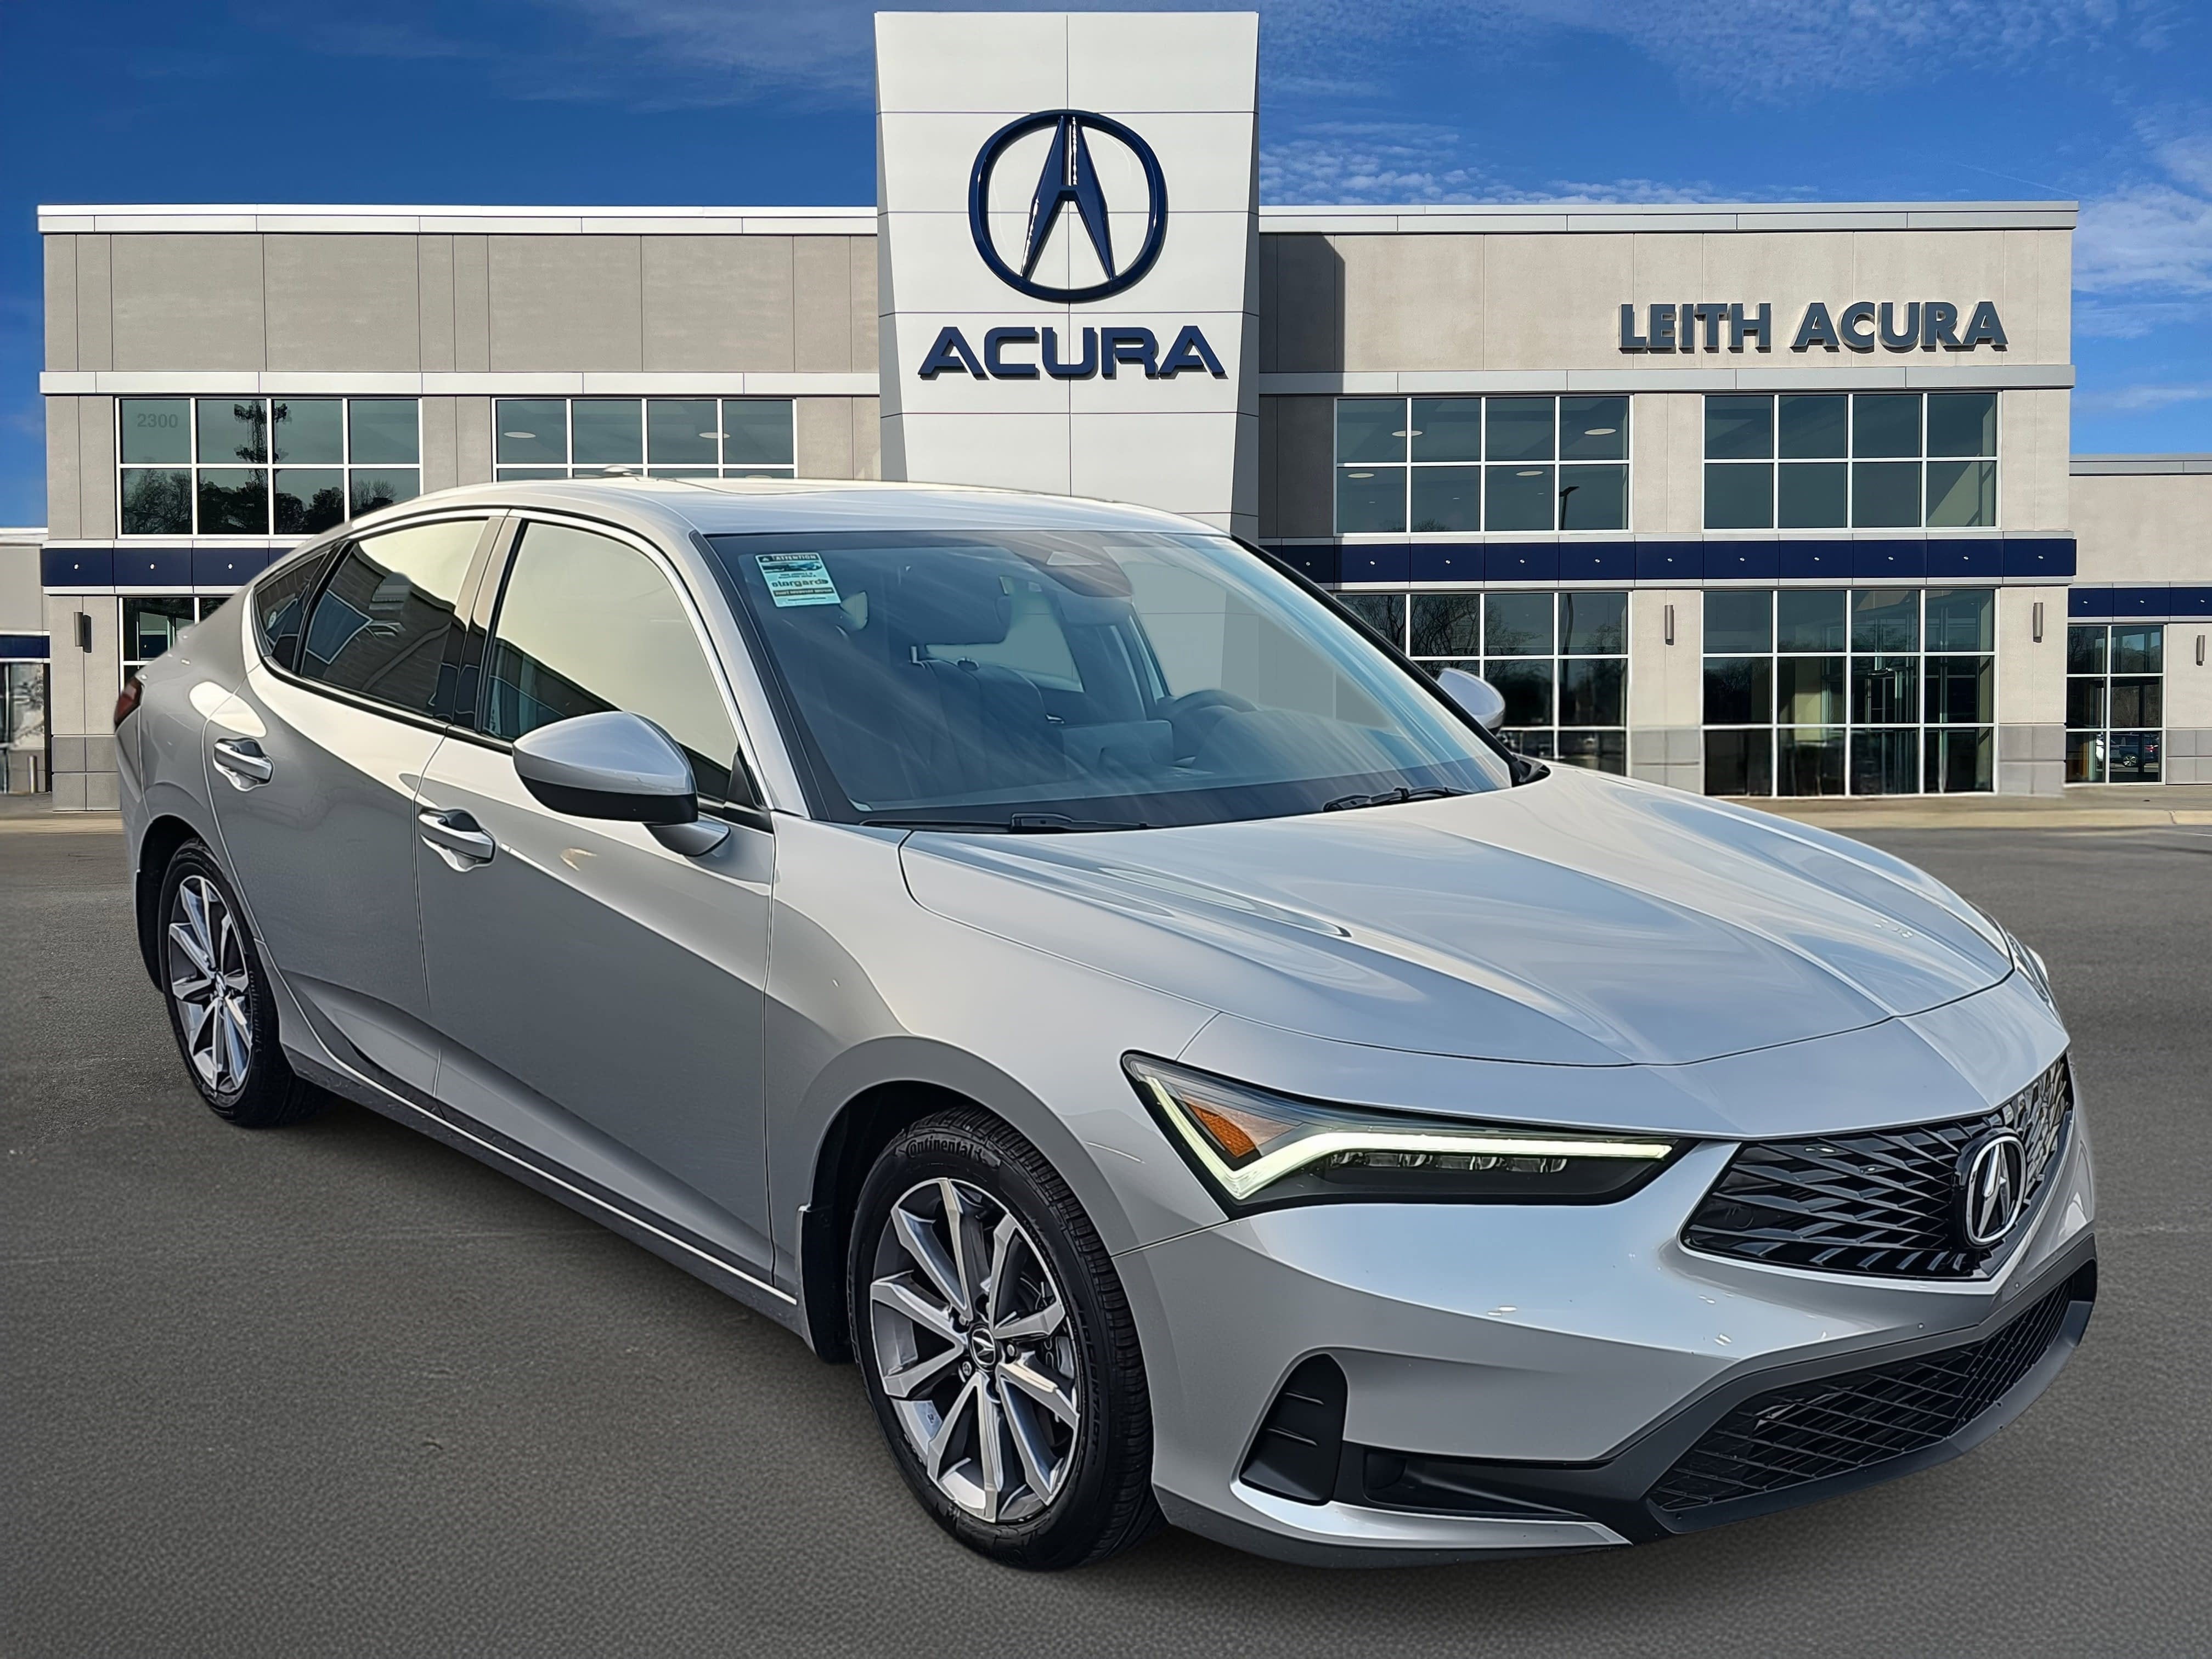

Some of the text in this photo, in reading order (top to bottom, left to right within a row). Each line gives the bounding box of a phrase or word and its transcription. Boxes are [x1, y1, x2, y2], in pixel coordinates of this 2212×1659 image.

[1618, 301, 2008, 354] LEITH ACURA
[917, 326, 1228, 380] ACURA
[137, 413, 178, 428] 2300
[907, 1135, 974, 1159] Continental
